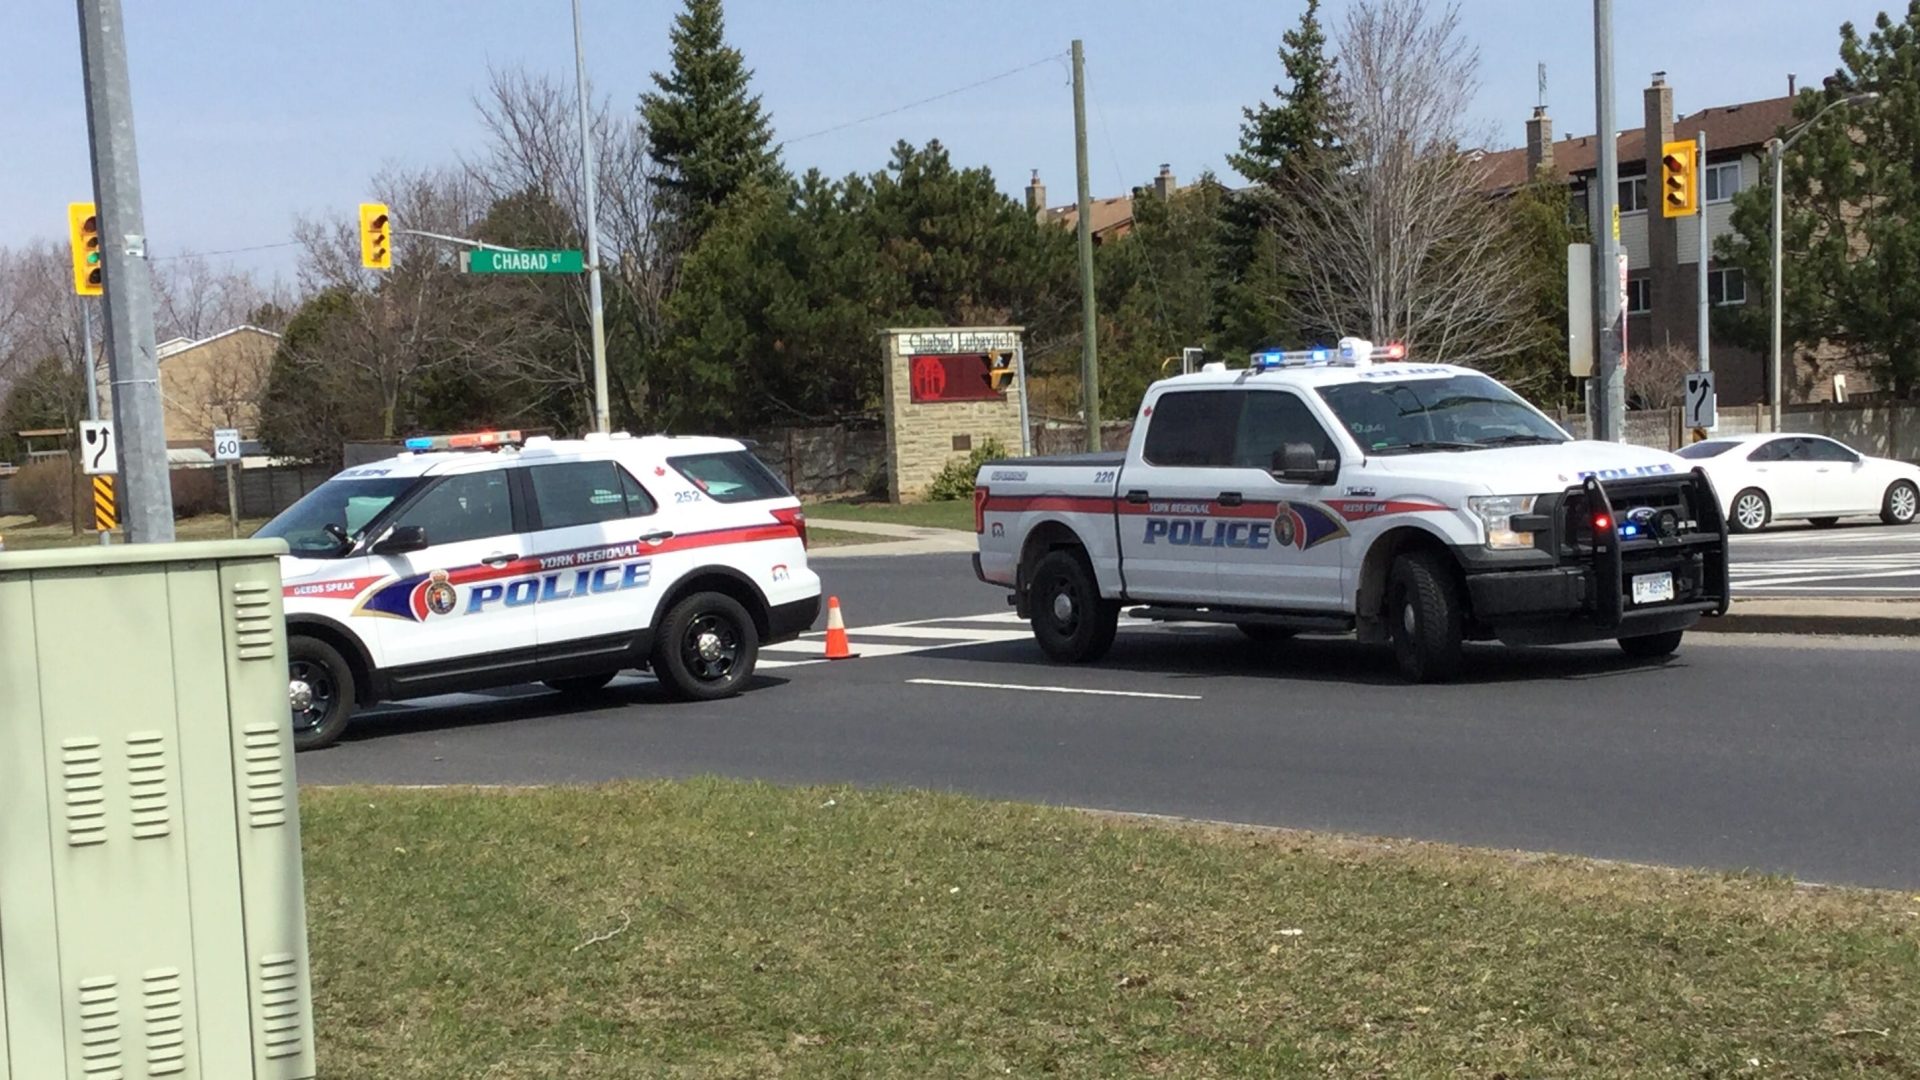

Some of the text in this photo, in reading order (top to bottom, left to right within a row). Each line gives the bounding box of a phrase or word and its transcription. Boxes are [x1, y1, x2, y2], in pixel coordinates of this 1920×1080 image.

[492, 253, 548, 270] CHABAD
[218, 440, 237, 455] 60
[1094, 471, 1115, 483] 220
[1577, 463, 1675, 481] POLICE
[674, 490, 702, 504] 252
[1171, 503, 1211, 514] REGIONAL
[1142, 517, 1272, 550] POLICE
[540, 544, 640, 570] YORK REGIONAL
[293, 581, 356, 595] DEEDS SPEAK
[463, 558, 652, 616] POLICE
